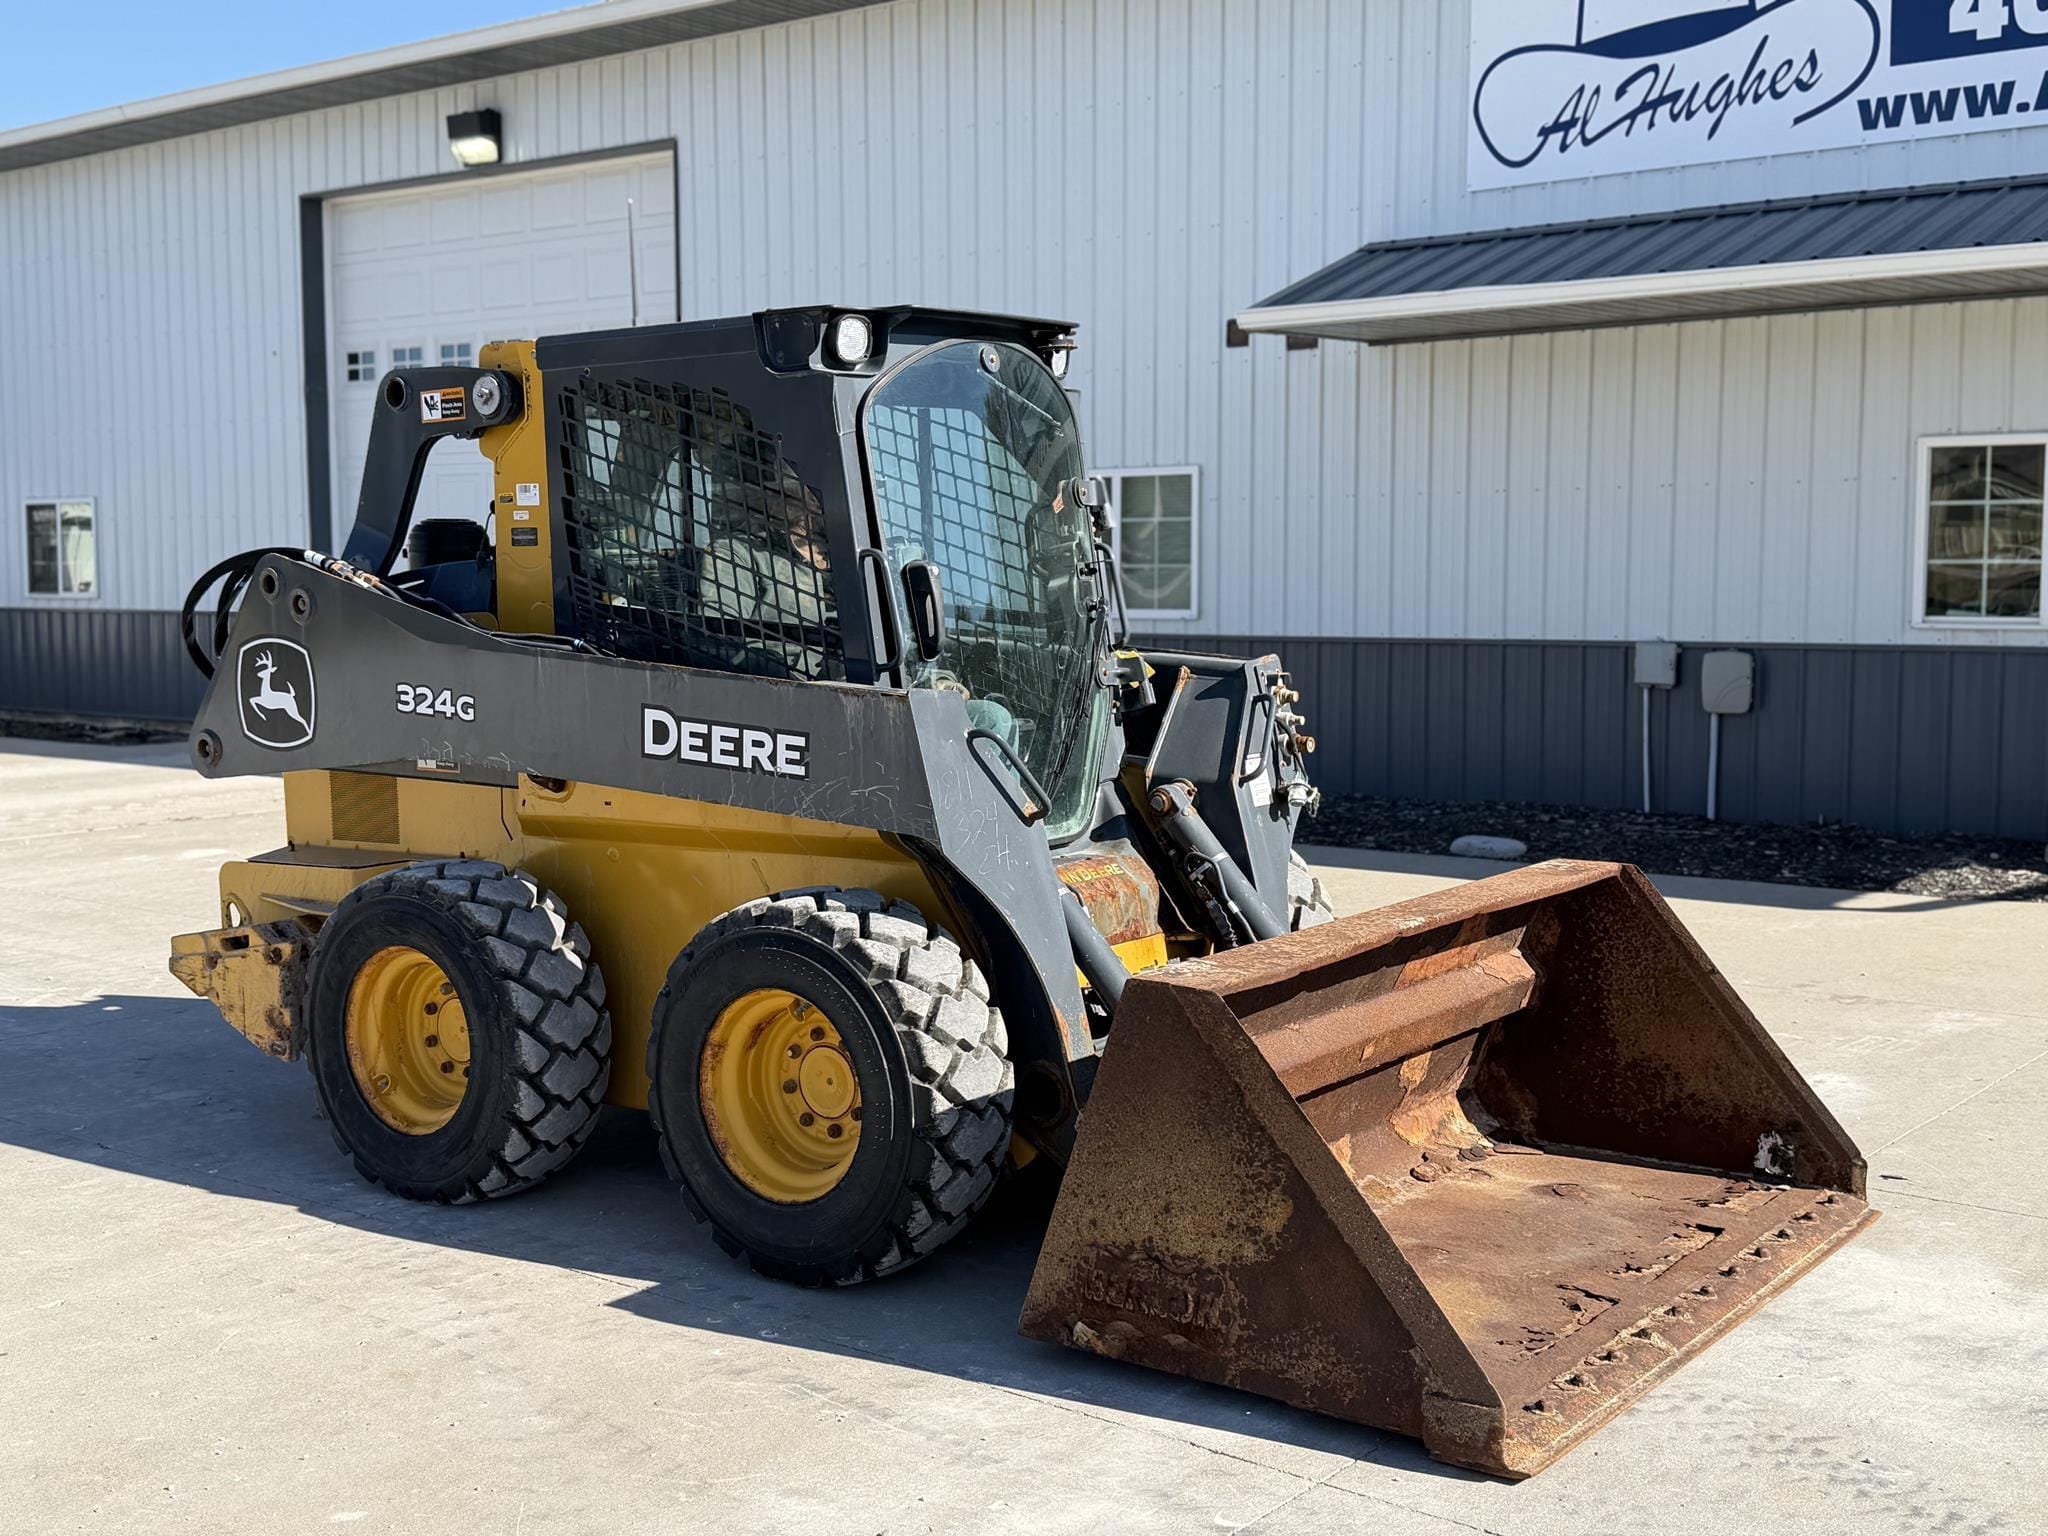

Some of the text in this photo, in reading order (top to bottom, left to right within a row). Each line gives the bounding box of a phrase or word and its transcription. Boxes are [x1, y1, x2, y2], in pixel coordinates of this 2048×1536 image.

[1537, 34, 1823, 153] Al Hughes
[397, 684, 475, 721] 324G
[644, 708, 806, 777] DEERE
